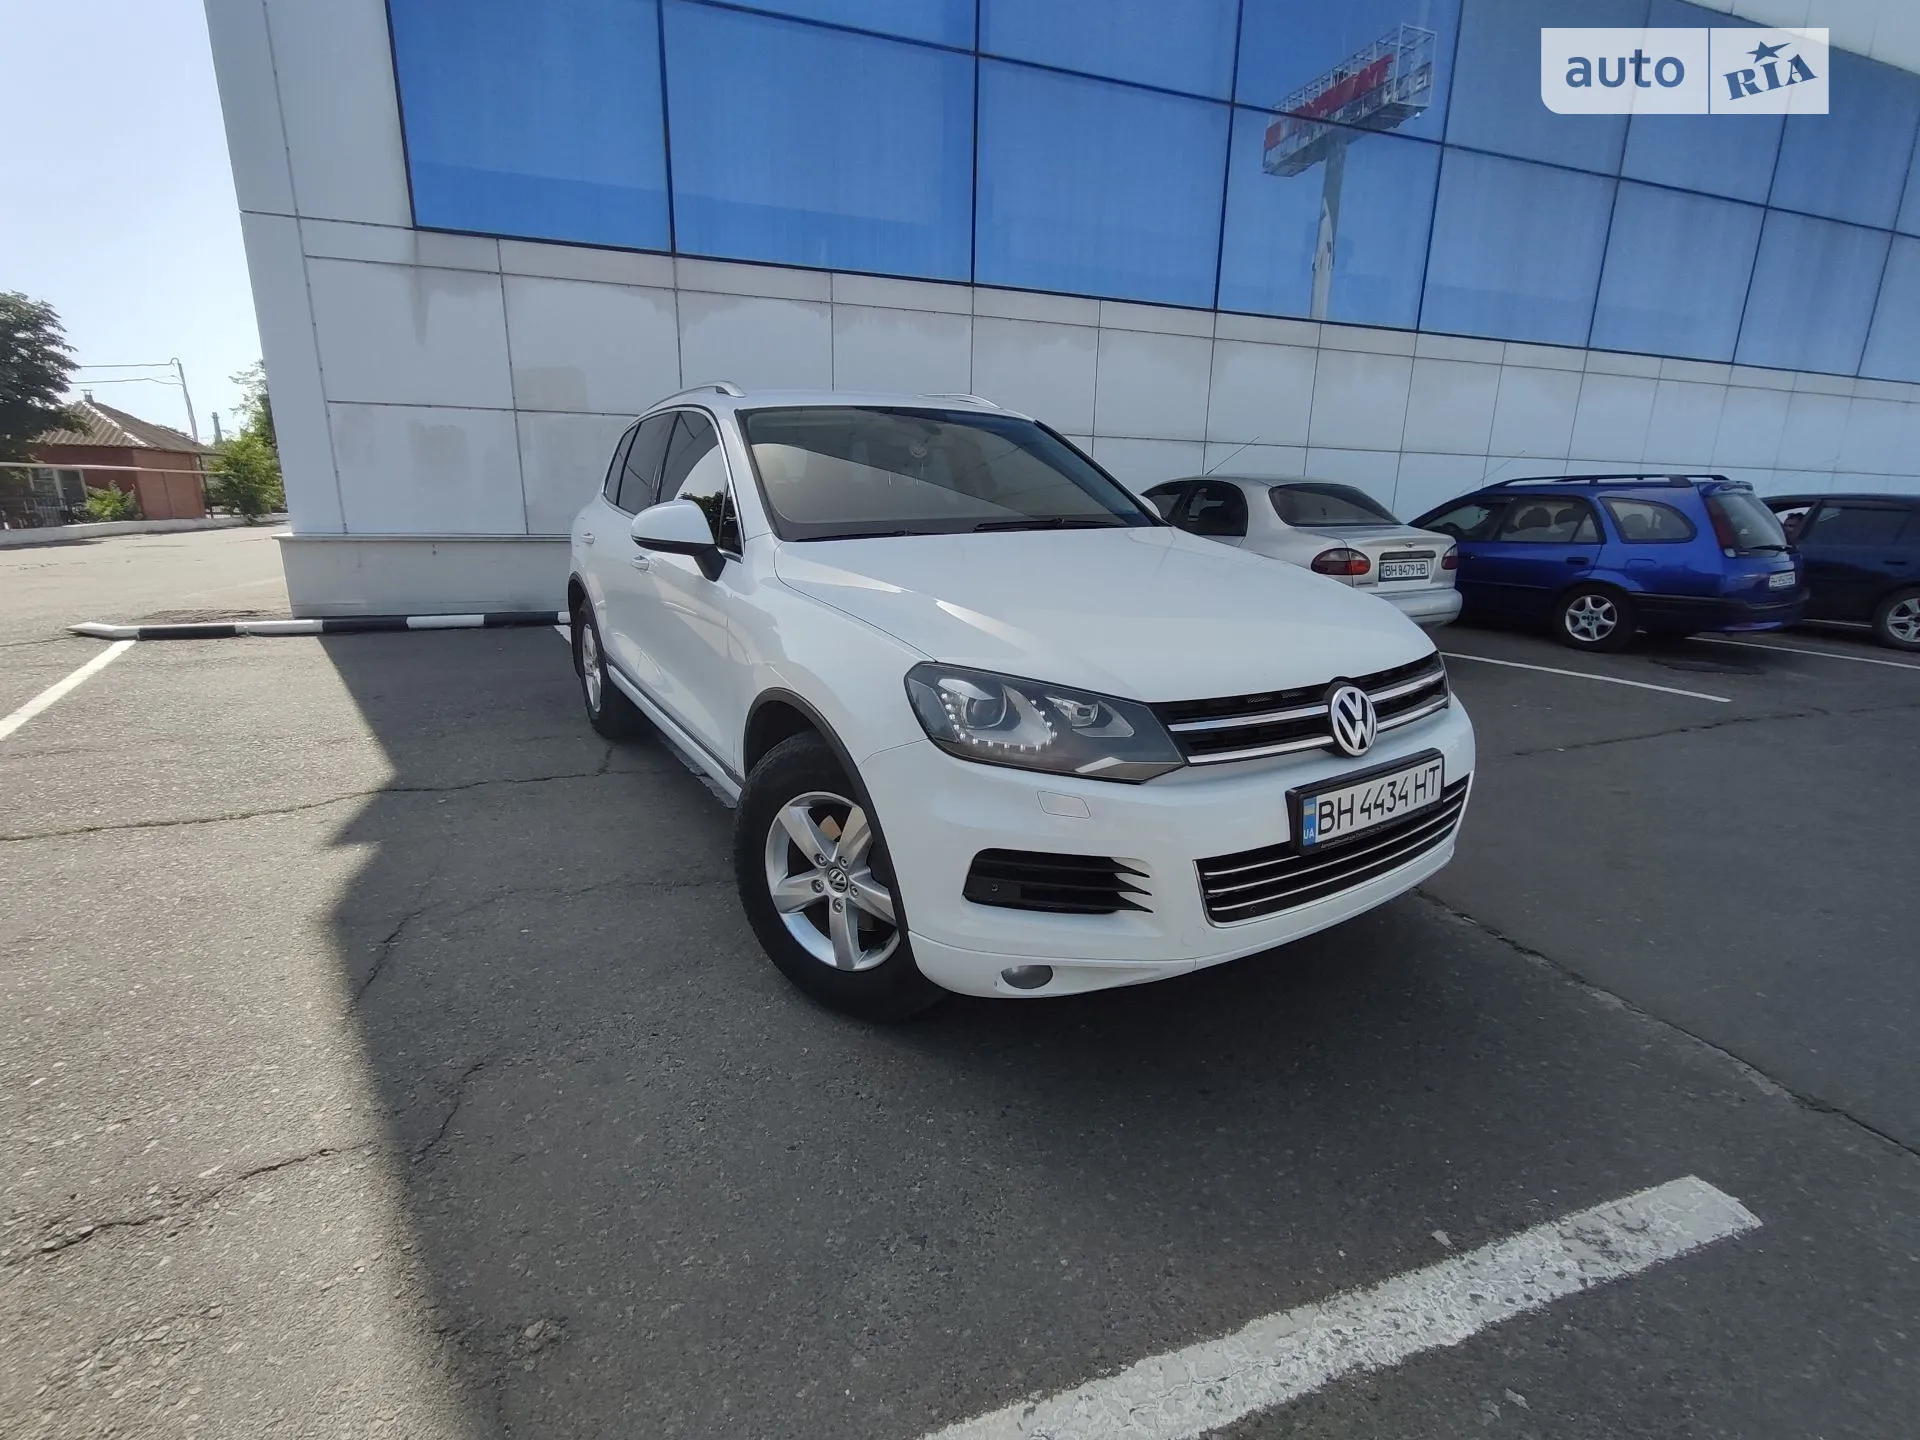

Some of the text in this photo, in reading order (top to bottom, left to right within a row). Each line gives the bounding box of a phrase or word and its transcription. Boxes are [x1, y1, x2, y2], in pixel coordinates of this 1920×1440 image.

[1385, 565, 1397, 577] BH
[1317, 793, 1355, 836] BH
[1359, 776, 1409, 820] 4434
[1414, 765, 1440, 803] HT
[1303, 828, 1315, 840] UA
